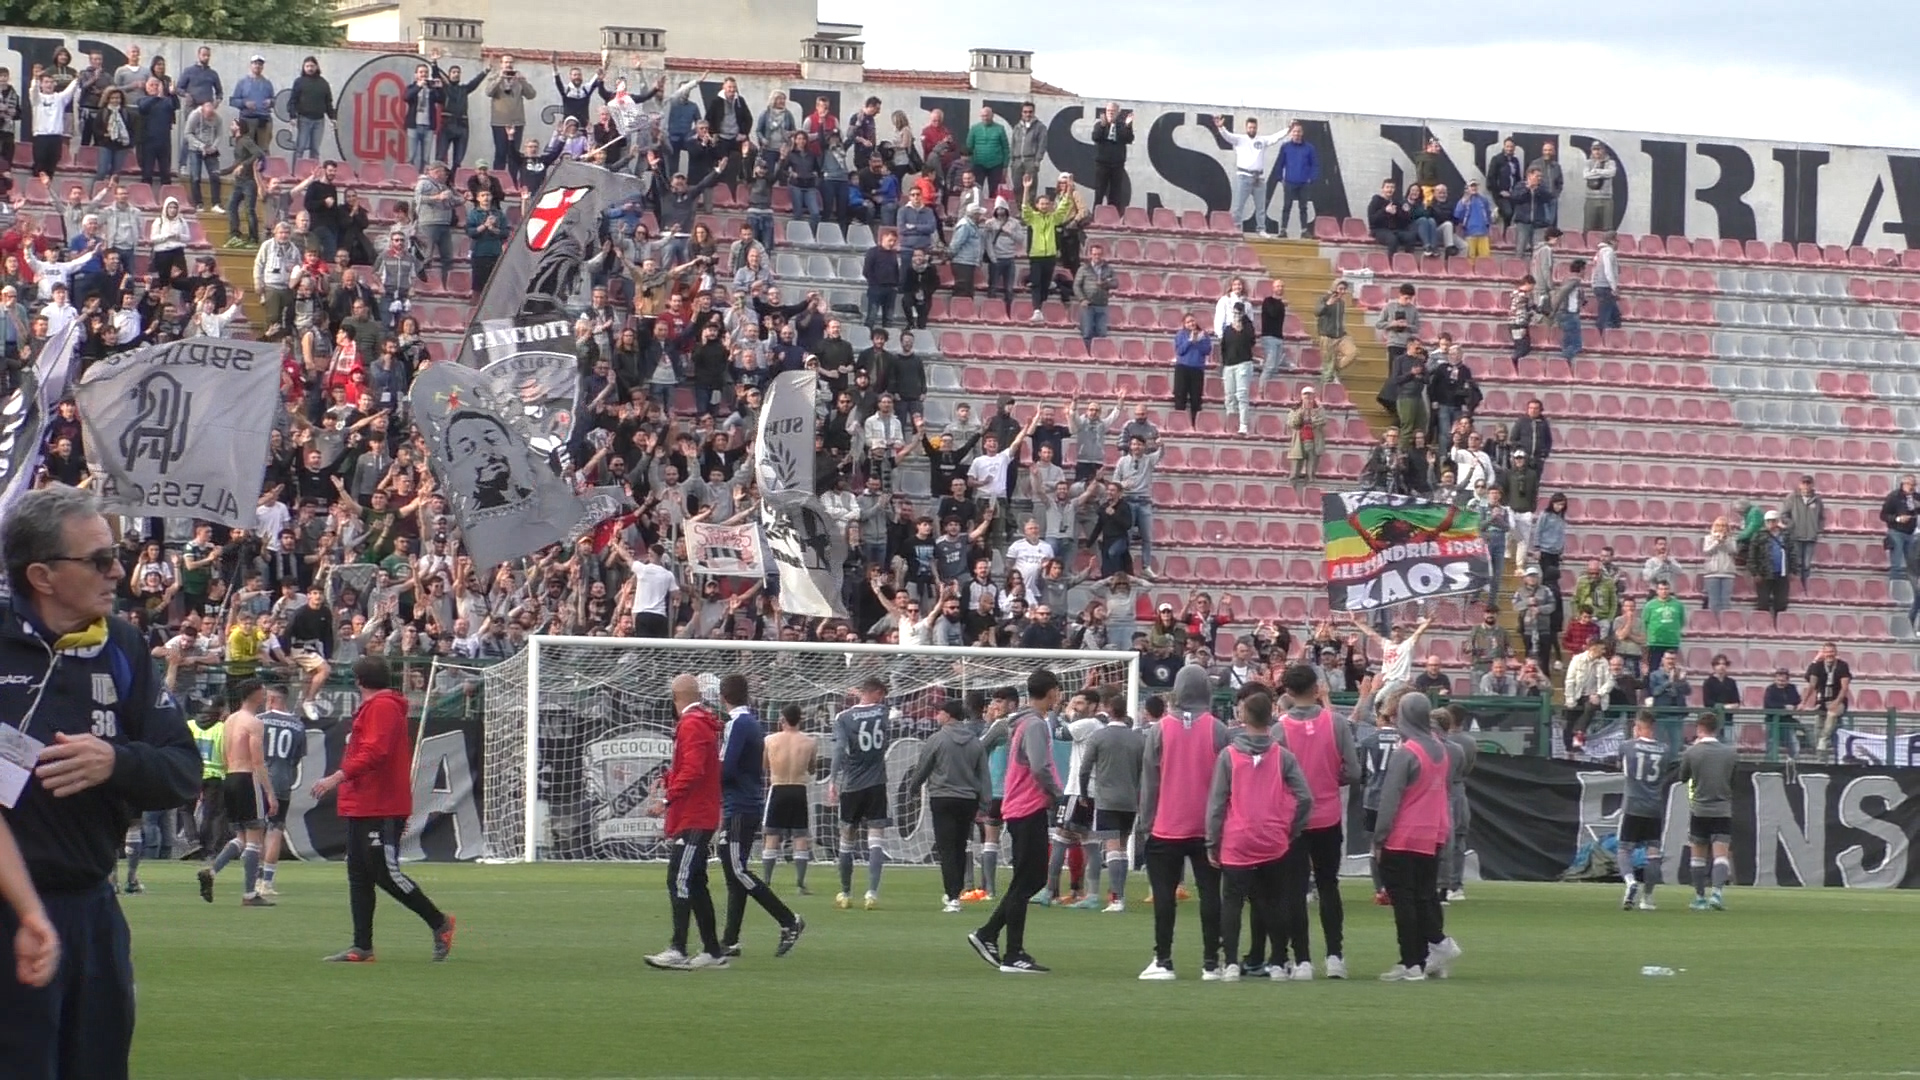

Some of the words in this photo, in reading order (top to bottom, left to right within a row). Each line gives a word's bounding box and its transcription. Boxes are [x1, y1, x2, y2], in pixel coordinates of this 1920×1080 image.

[1331, 541, 1441, 579] ALESSANDRIA
[1345, 562, 1471, 610] KAOS
[91, 710, 117, 737] 38
[858, 718, 884, 751] 66
[267, 726, 293, 759] 10
[602, 741, 652, 756] ECCOCI
[1379, 742, 1400, 771] 7
[1635, 751, 1662, 782] 13
